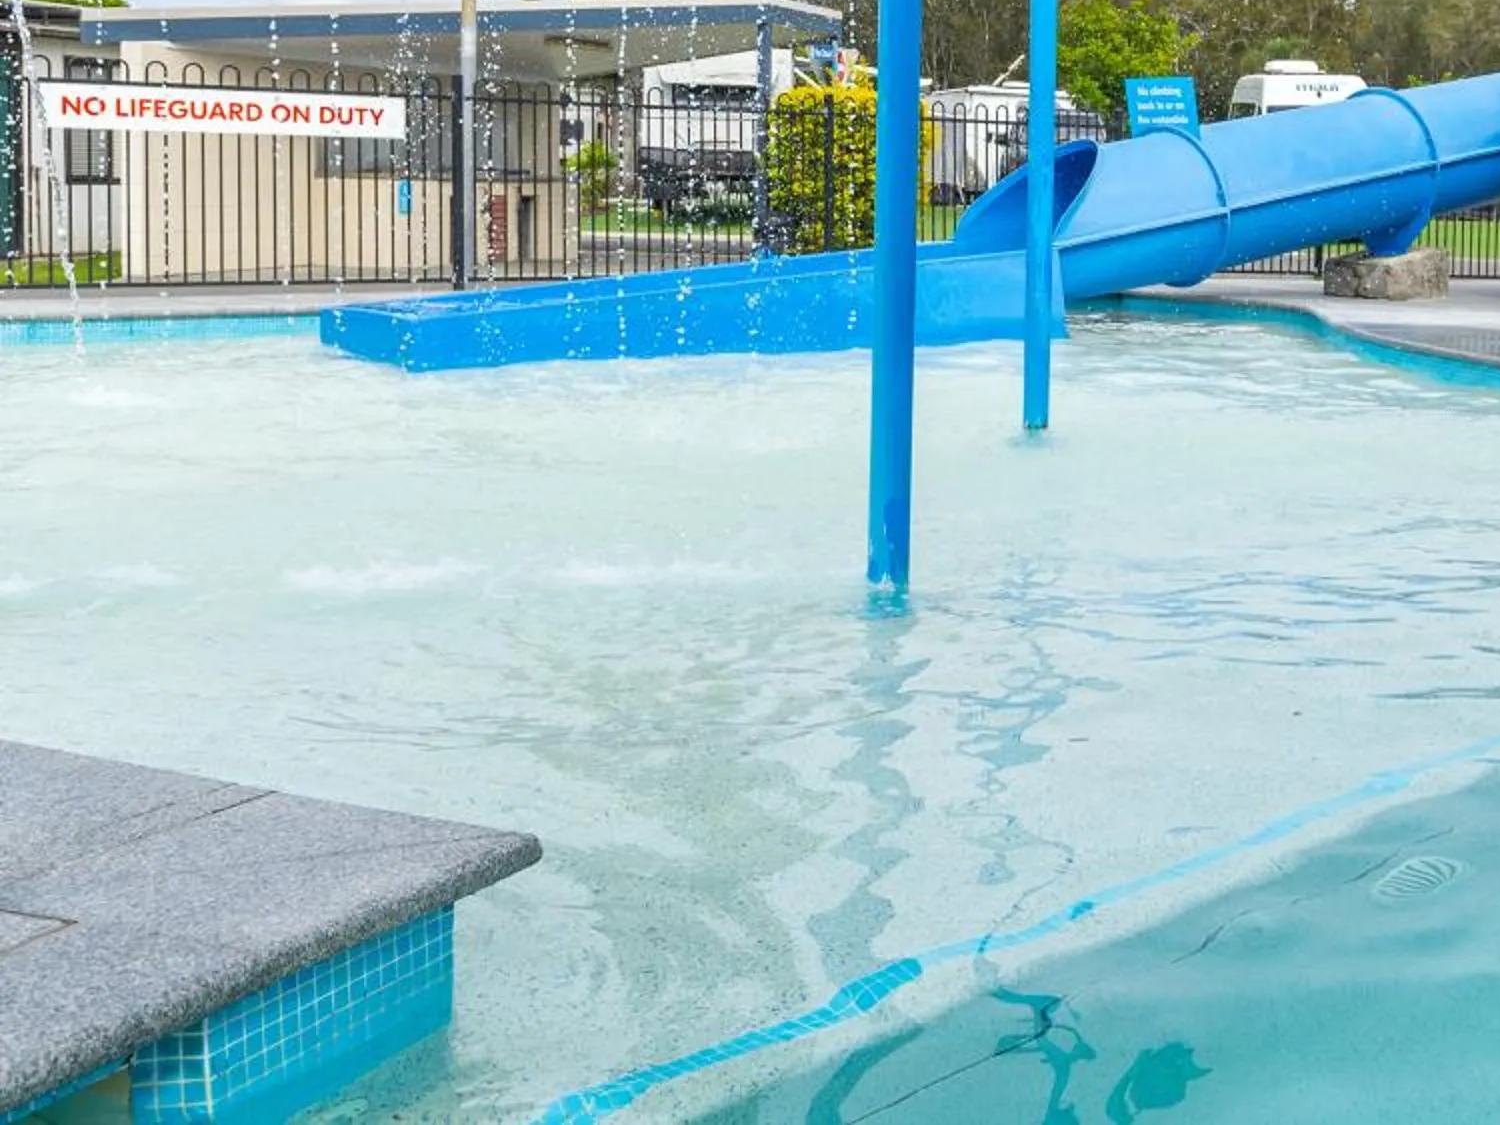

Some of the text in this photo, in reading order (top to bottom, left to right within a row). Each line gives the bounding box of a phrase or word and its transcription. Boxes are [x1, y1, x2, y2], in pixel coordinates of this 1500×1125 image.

[61, 95, 384, 126] NO LIFEGUARD ON DUTY
